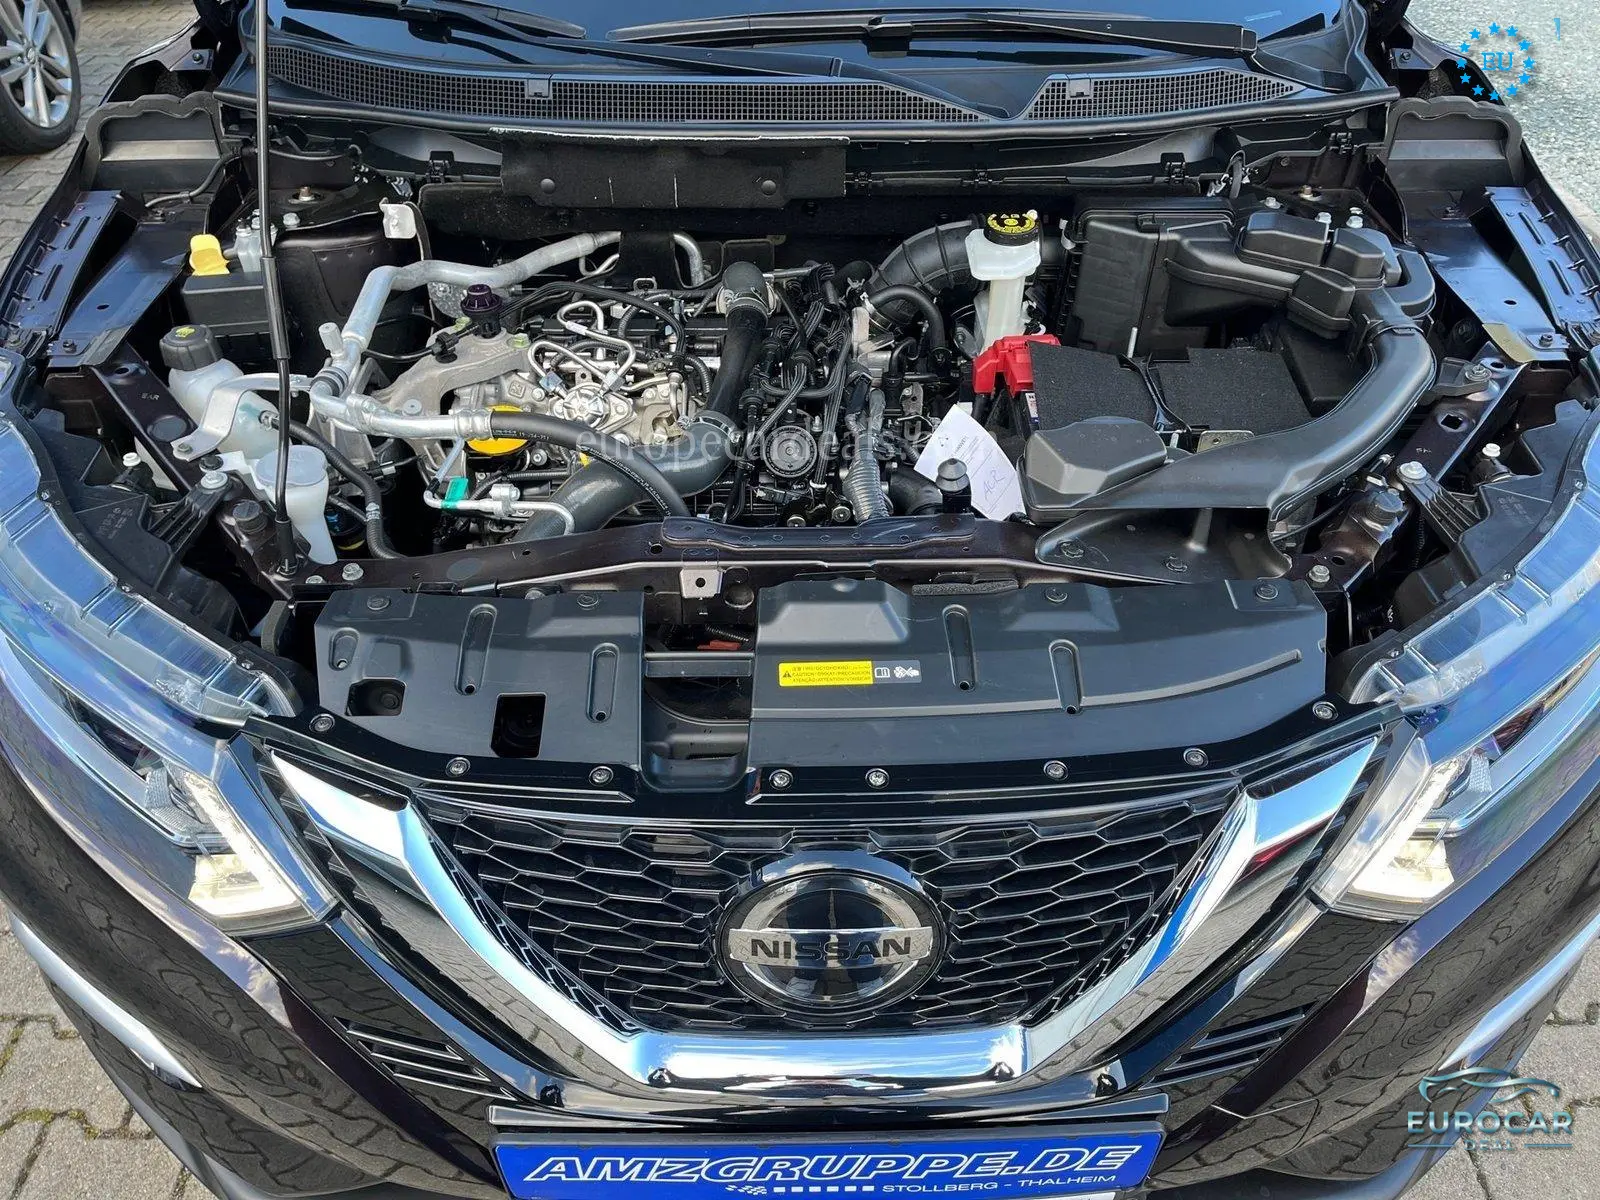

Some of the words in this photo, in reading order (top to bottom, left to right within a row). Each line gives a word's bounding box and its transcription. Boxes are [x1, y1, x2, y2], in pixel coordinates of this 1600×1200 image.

[750, 936, 912, 961] NISSAN
[523, 1145, 1142, 1183] AMZGRUPPE.DE
[882, 1182, 998, 1193] STOLLBERG
[1018, 1175, 1117, 1188] THALHEIM
